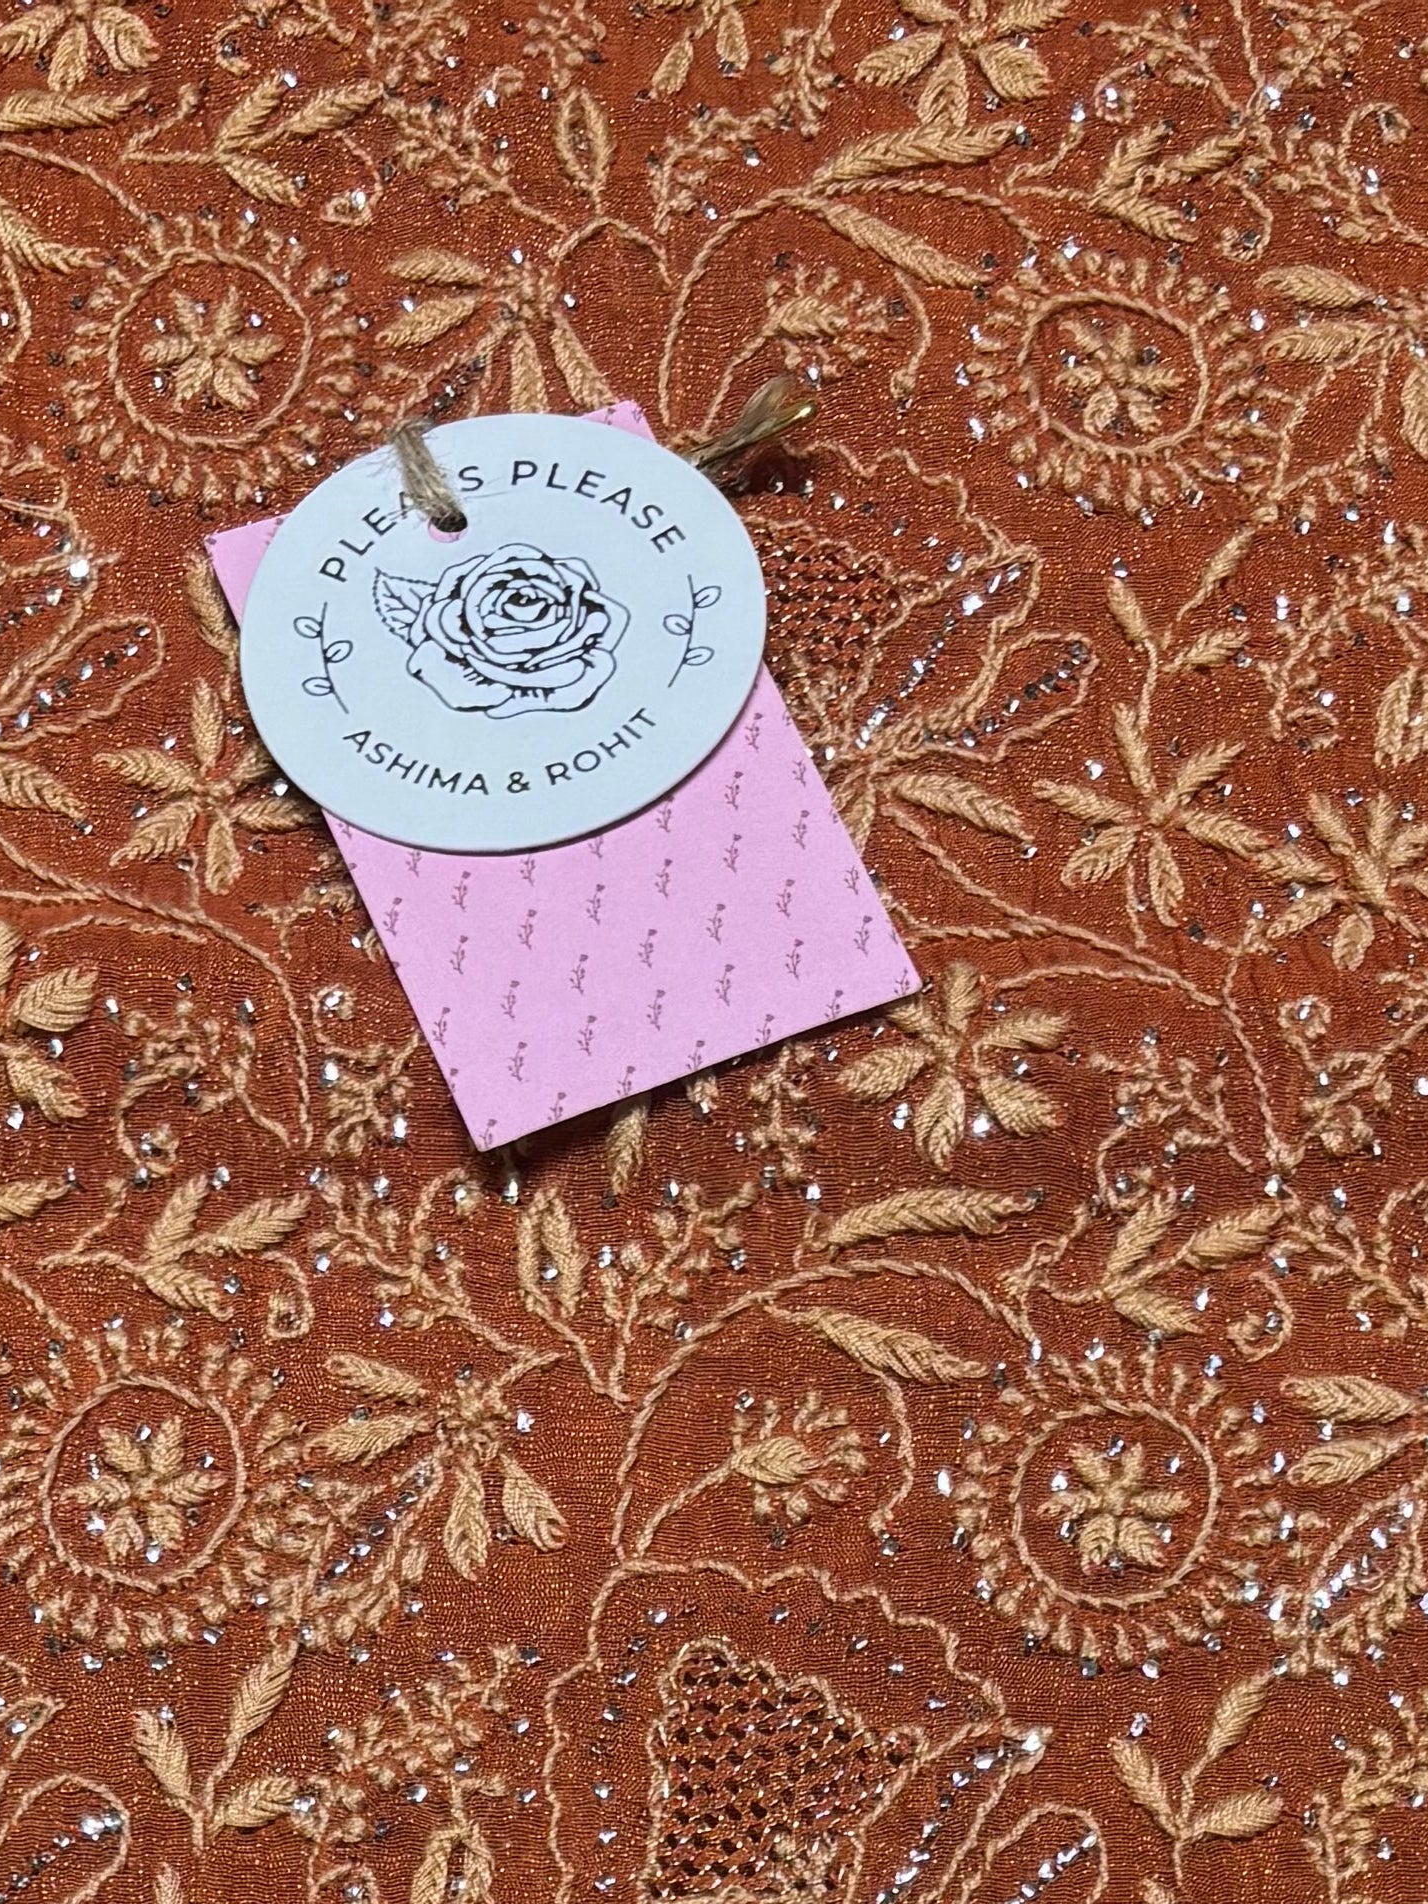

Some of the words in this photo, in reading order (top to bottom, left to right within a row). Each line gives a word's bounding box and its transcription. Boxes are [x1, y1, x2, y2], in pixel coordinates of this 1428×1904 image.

[319, 466, 484, 583] PLEAS
[511, 460, 686, 553] PLEASE
[343, 730, 489, 795] ASHIMA
[507, 771, 531, 793] &
[545, 708, 656, 786] ROHIT
